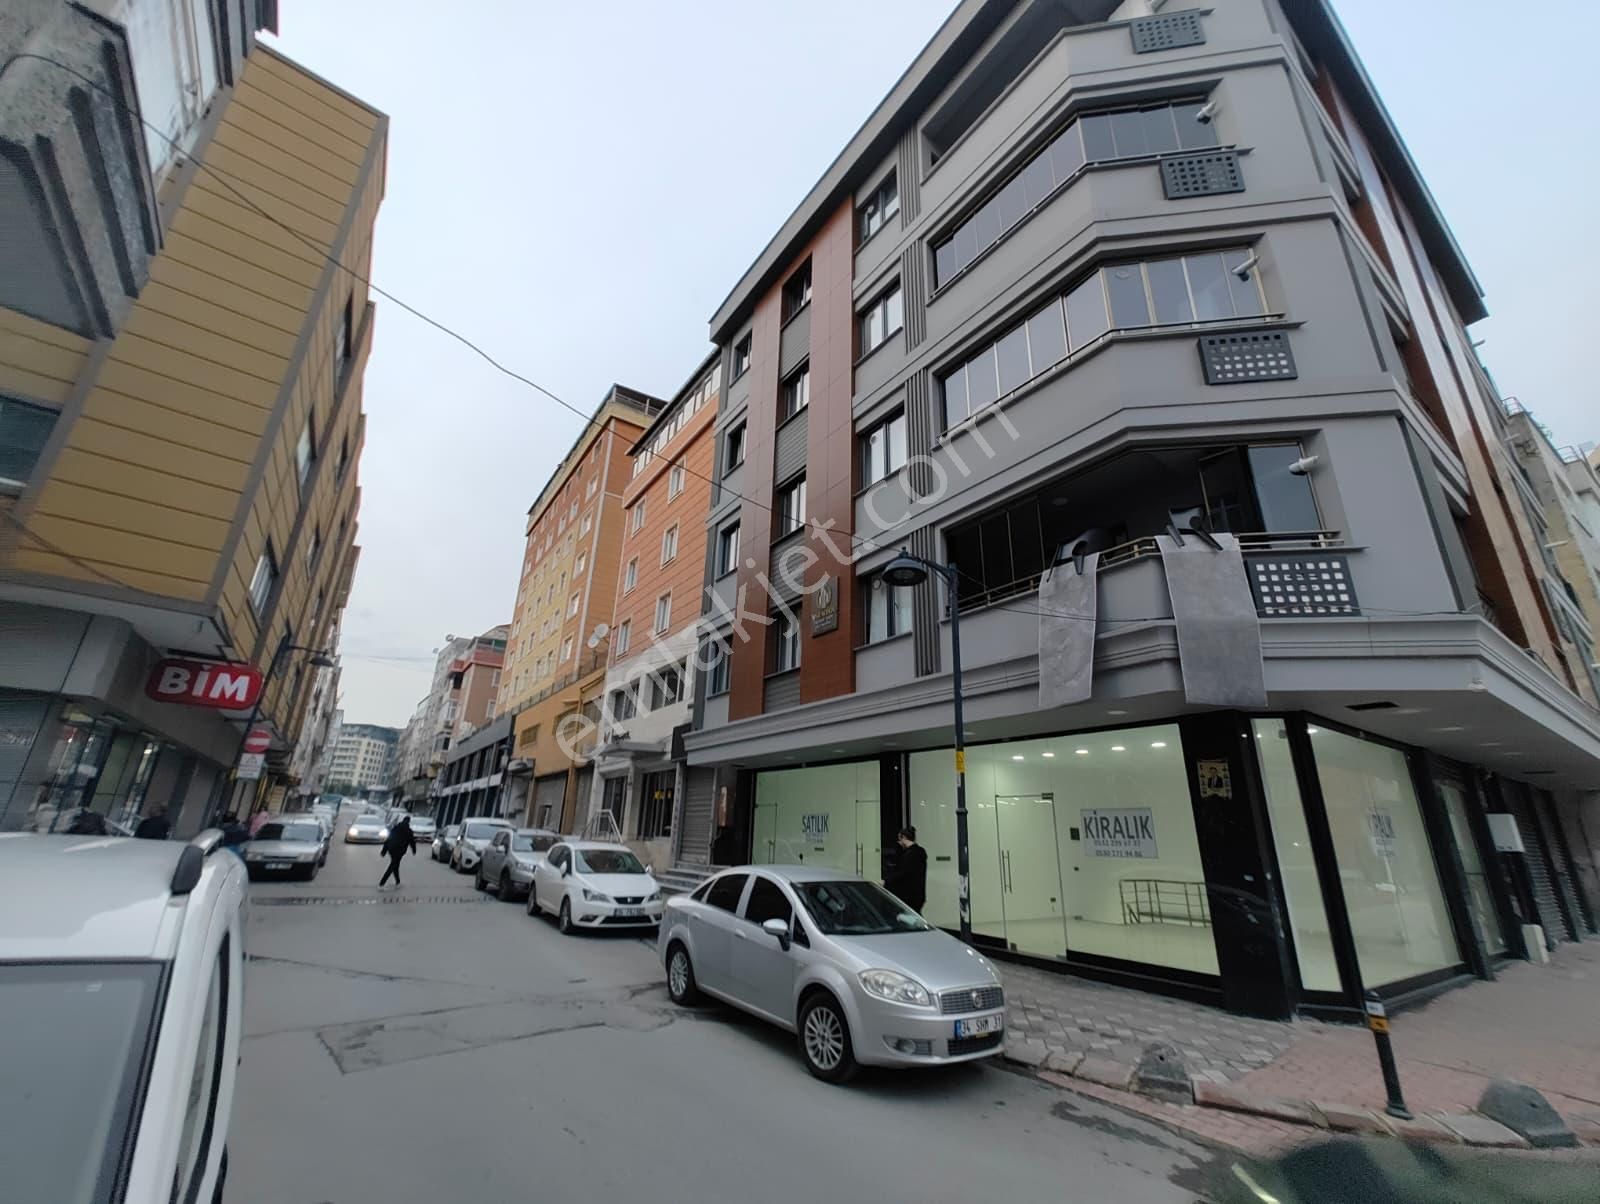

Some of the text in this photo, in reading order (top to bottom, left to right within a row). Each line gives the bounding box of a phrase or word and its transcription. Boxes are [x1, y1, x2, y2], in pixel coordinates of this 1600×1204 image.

[157, 664, 250, 702] BİM
[802, 814, 830, 833] SATILIK
[1083, 809, 1153, 839] KİRALIK
[961, 1020, 971, 1035] 34
